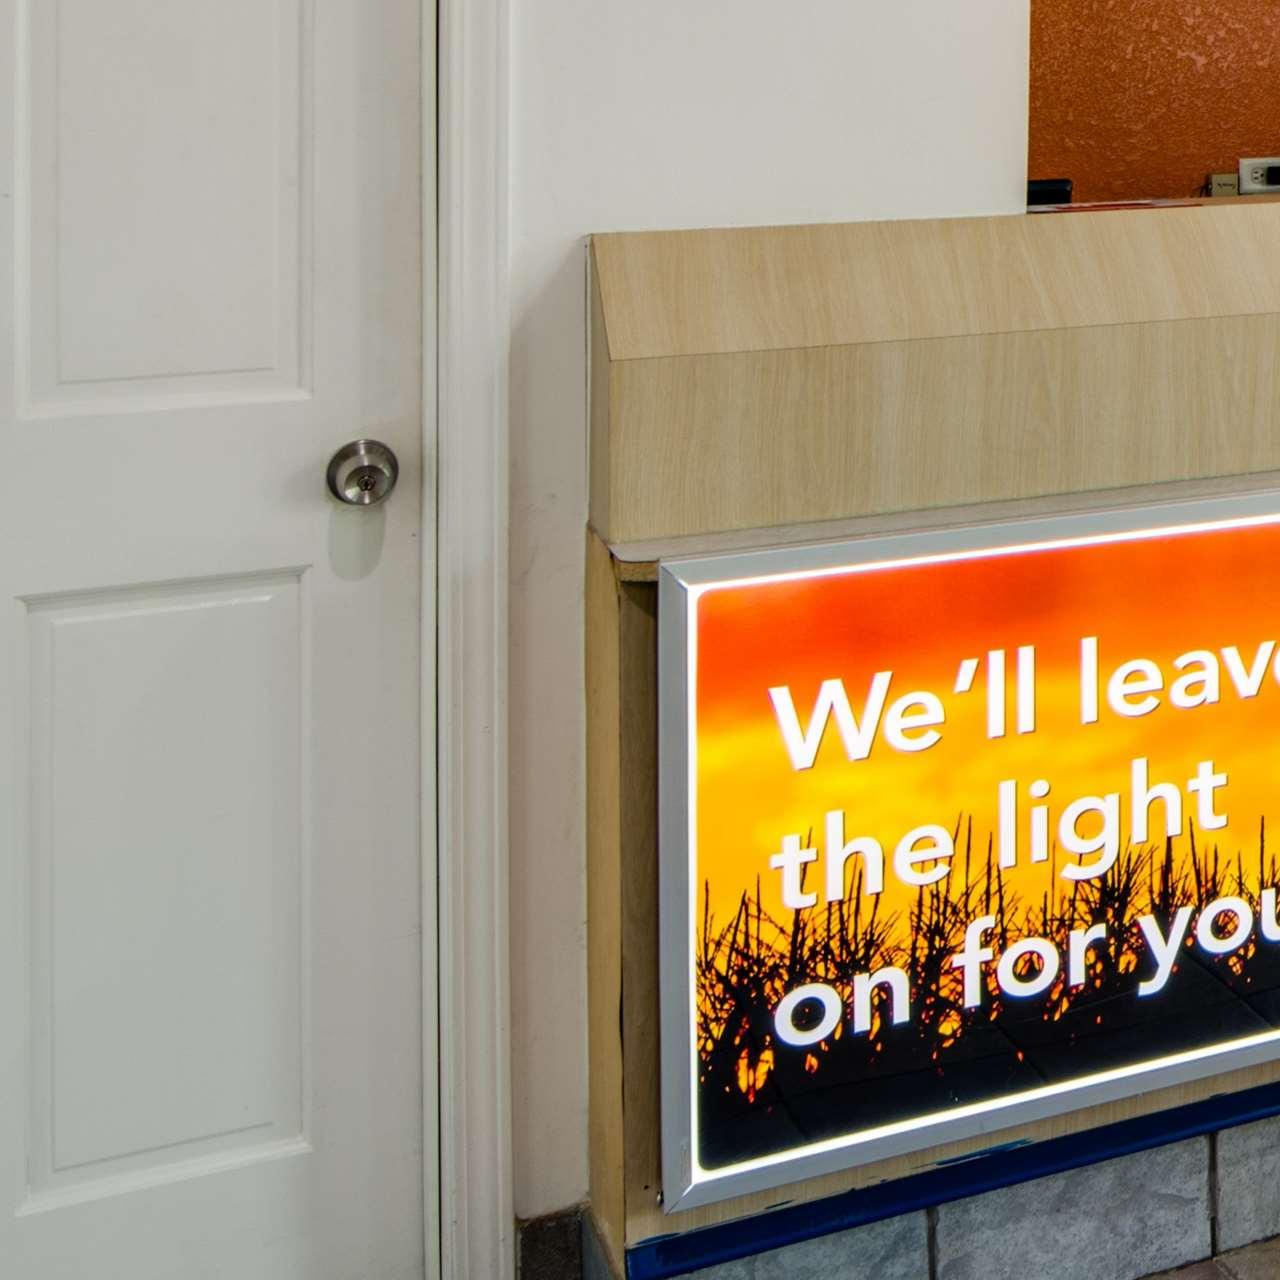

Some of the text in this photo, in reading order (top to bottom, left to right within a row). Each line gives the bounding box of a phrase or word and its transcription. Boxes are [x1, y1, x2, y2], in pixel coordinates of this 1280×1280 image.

[768, 646, 1036, 771] We'll
[769, 757, 1229, 910] the light
[773, 961, 911, 1047] on
[952, 914, 1108, 1010] for
